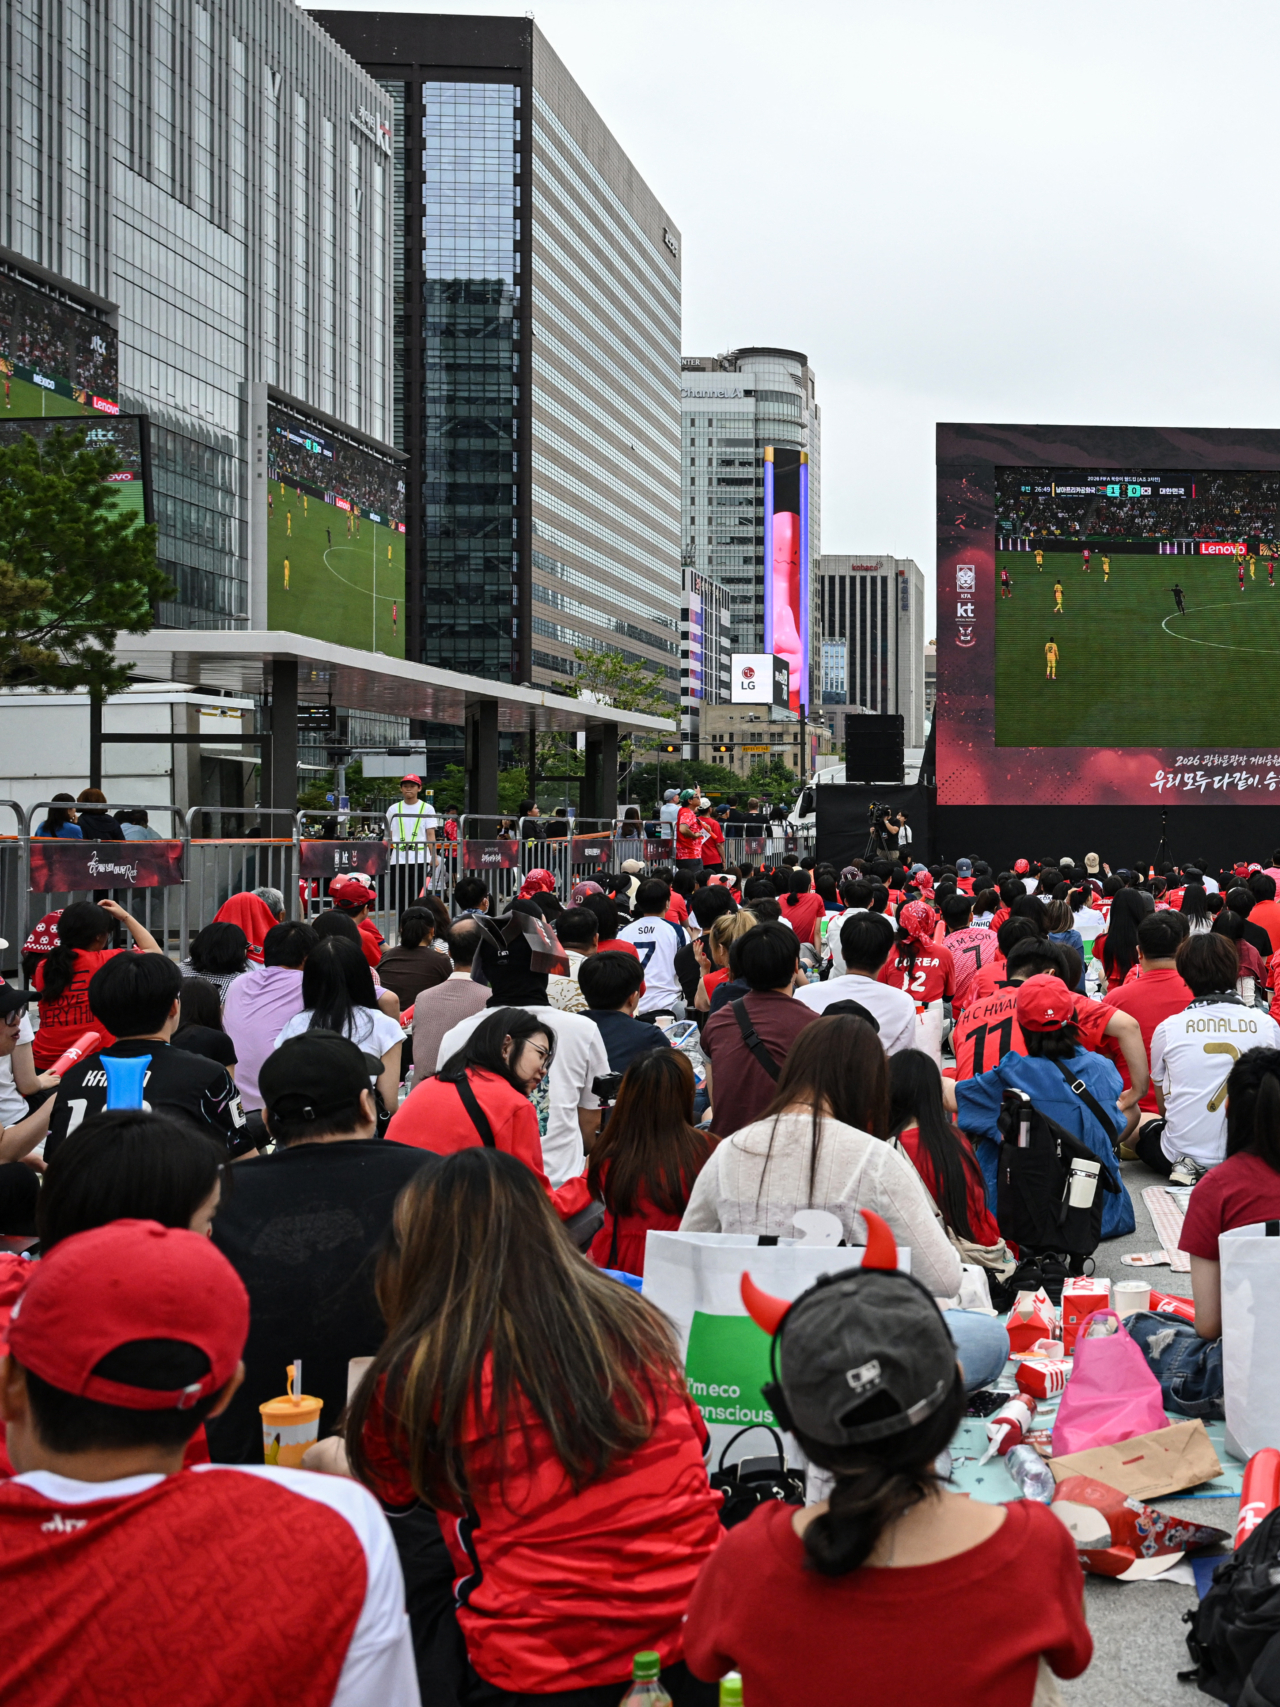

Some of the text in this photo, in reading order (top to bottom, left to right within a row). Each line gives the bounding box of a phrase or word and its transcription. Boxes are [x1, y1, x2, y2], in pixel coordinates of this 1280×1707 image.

[375, 112, 392, 157] kt
[1159, 487, 1185, 495] 대한민국
[1201, 543, 1246, 555] Lenovo
[956, 602, 975, 617] kt
[741, 681, 756, 691] LG
[1176, 754, 1200, 767] 2026
[1202, 754, 1248, 767] 광화문광장
[1149, 769, 1182, 794] 우리
[1182, 770, 1212, 794] 모두
[637, 925, 656, 935] SON
[946, 932, 992, 951] H M SON
[633, 940, 657, 970] 7
[962, 944, 982, 970] 7
[962, 998, 1017, 1025] H C HWA
[1185, 1018, 1258, 1034] RONALDO
[965, 1015, 1013, 1077] 11
[1203, 1042, 1243, 1113] 7
[708, 1383, 741, 1398] eco
[698, 1404, 774, 1423] onscious
